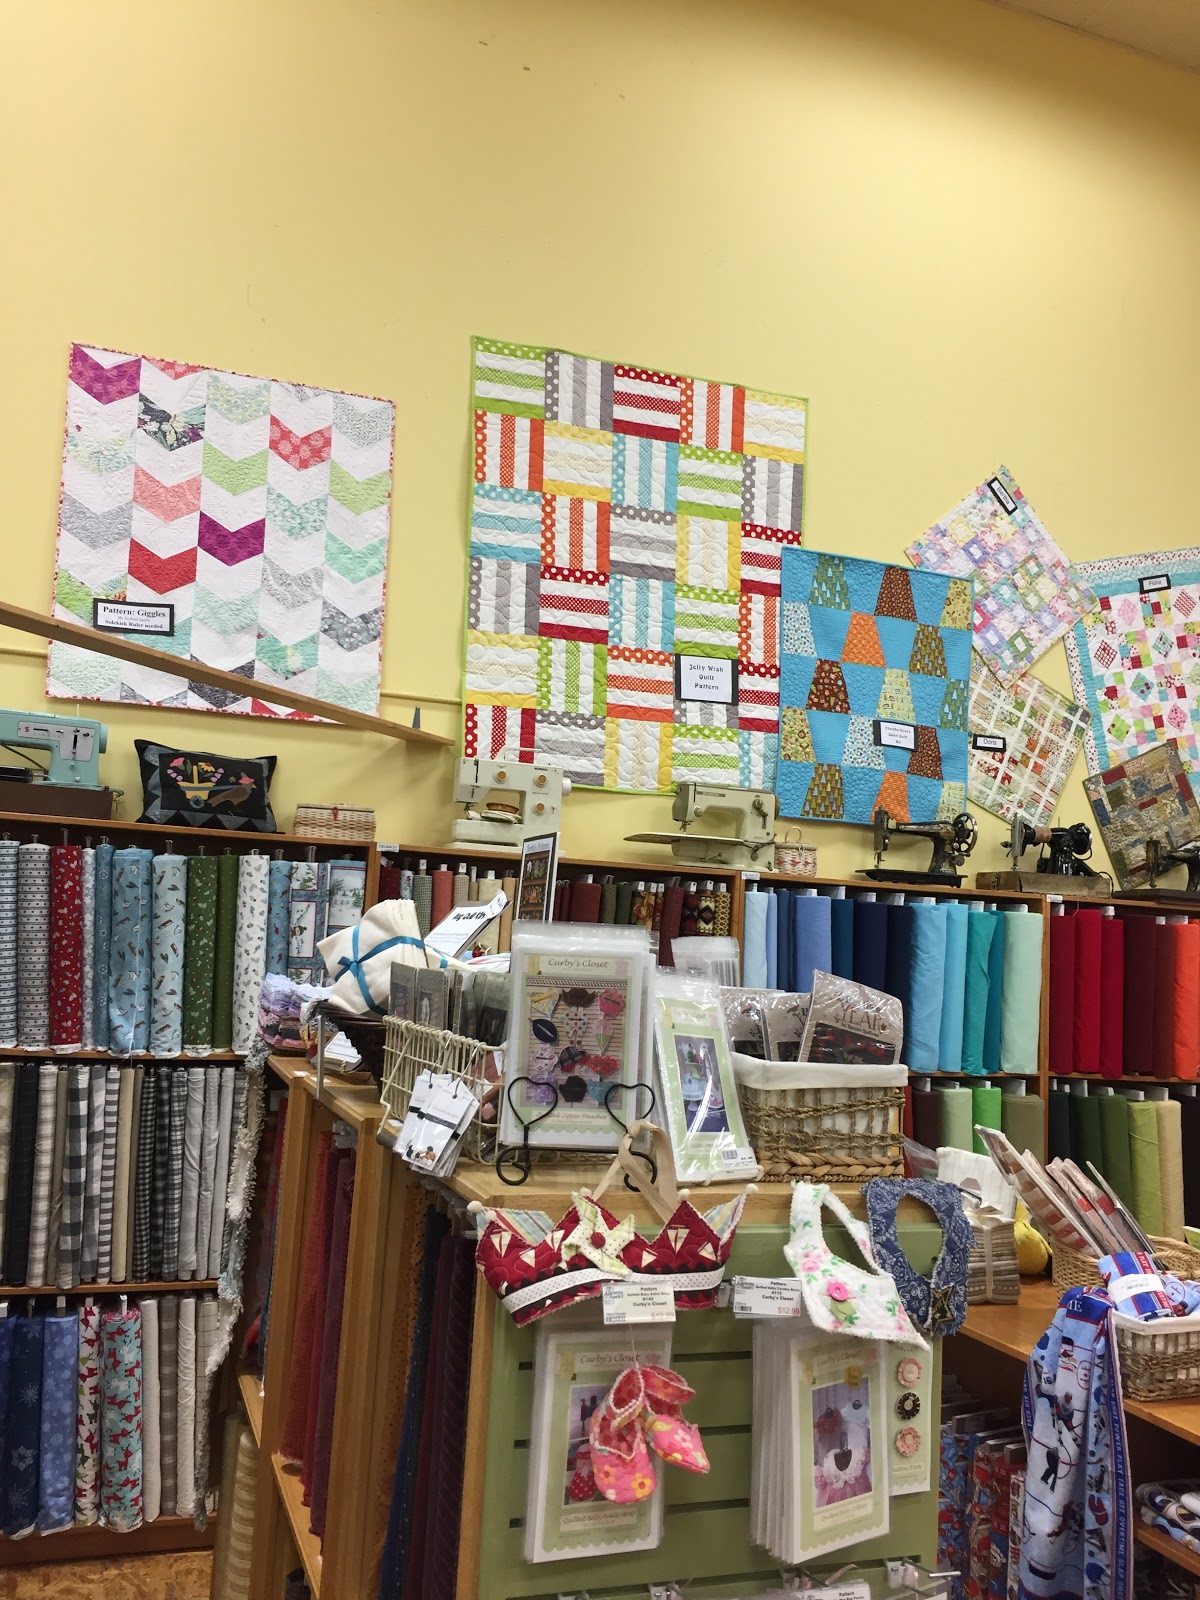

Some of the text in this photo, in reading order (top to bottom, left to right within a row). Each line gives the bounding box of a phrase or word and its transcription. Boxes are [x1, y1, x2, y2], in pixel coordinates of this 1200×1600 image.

[996, 486, 1010, 505] Bertha
[103, 606, 166, 618] Pattern: Giggles
[548, 959, 609, 968] Curby's Closet
[840, 1002, 882, 1032] YEAR
[778, 1306, 800, 1315] $12.99
[580, 1354, 612, 1364] Curby's
[1113, 1422, 1122, 1451] POWER
